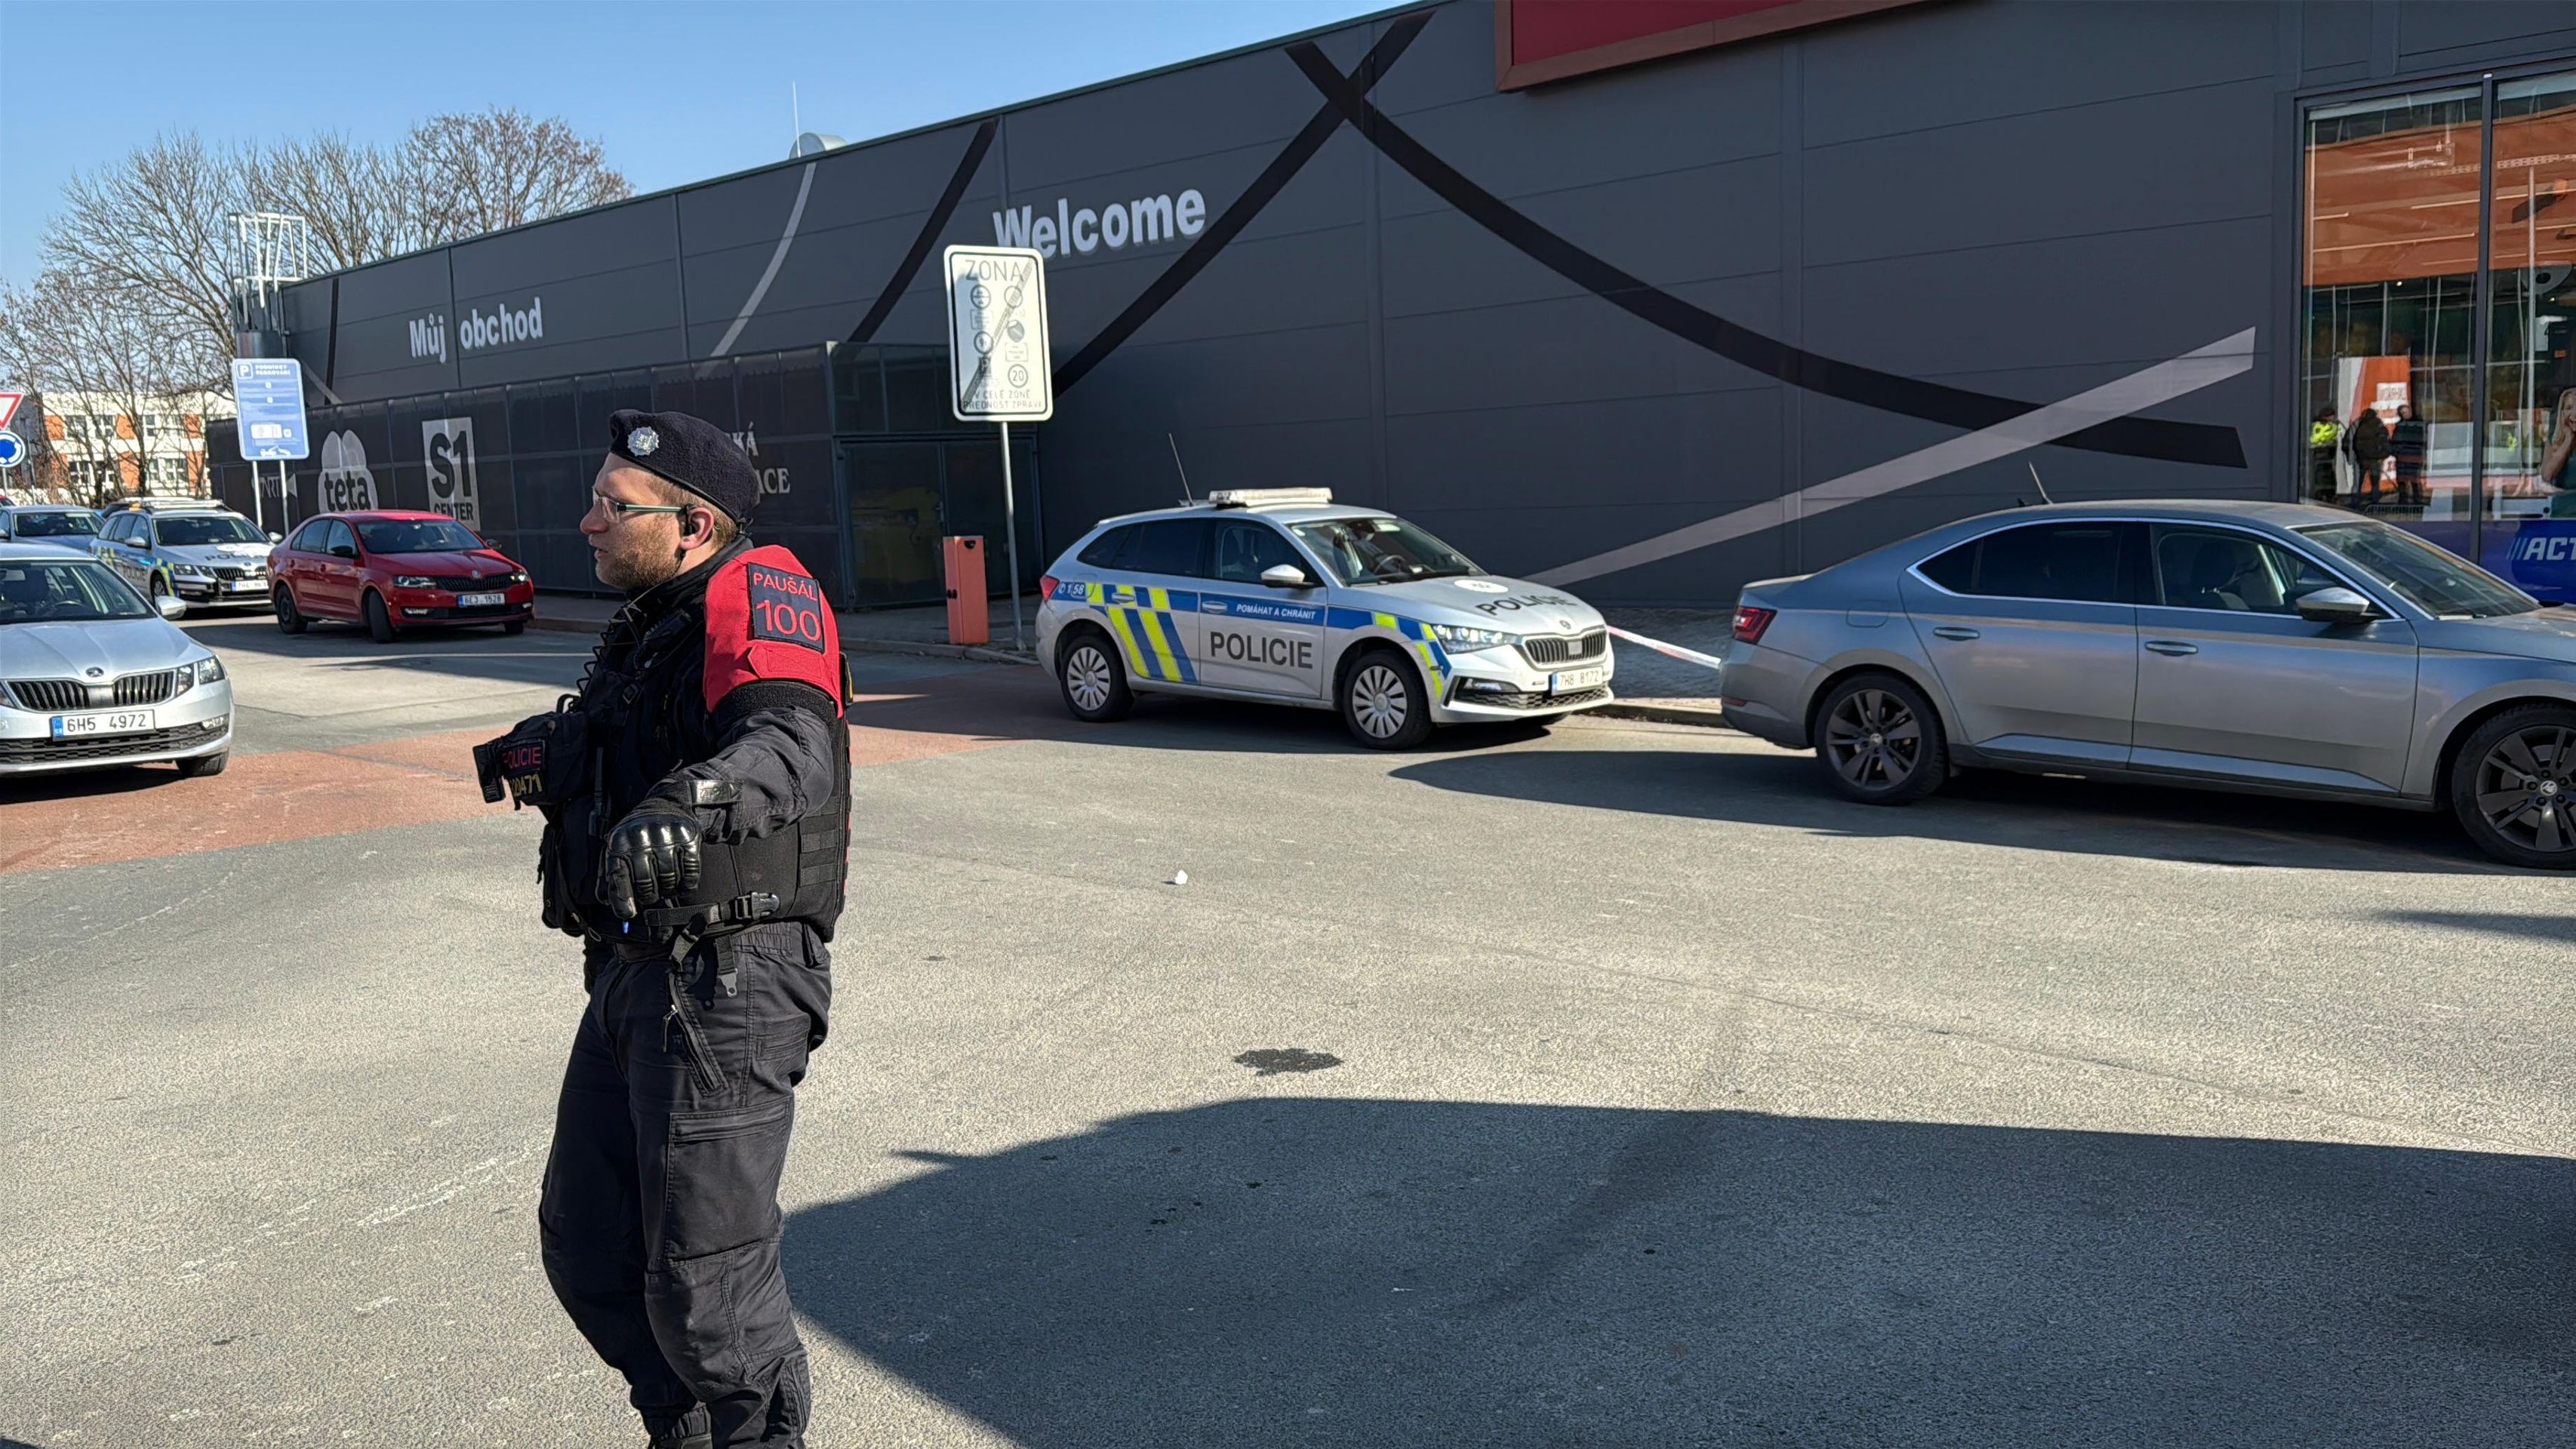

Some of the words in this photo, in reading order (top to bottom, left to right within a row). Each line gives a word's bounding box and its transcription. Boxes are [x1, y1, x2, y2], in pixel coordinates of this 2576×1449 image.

[993, 189, 1206, 260] Welcome
[409, 312, 447, 363] Můj
[460, 297, 543, 349] obchod
[1012, 371, 1025, 381] 20
[429, 430, 472, 499] S1
[324, 470, 371, 512] teta
[433, 502, 474, 521] CENTER
[753, 572, 817, 601] PAUŠÁL
[756, 599, 822, 641] 100
[1236, 604, 1273, 616] POMÁHAT
[1273, 608, 1280, 617] A
[1281, 608, 1316, 620] CHRÁNIT
[1210, 631, 1313, 669] POLICIE
[66, 717, 96, 732] 6H5
[109, 714, 146, 729] 4972
